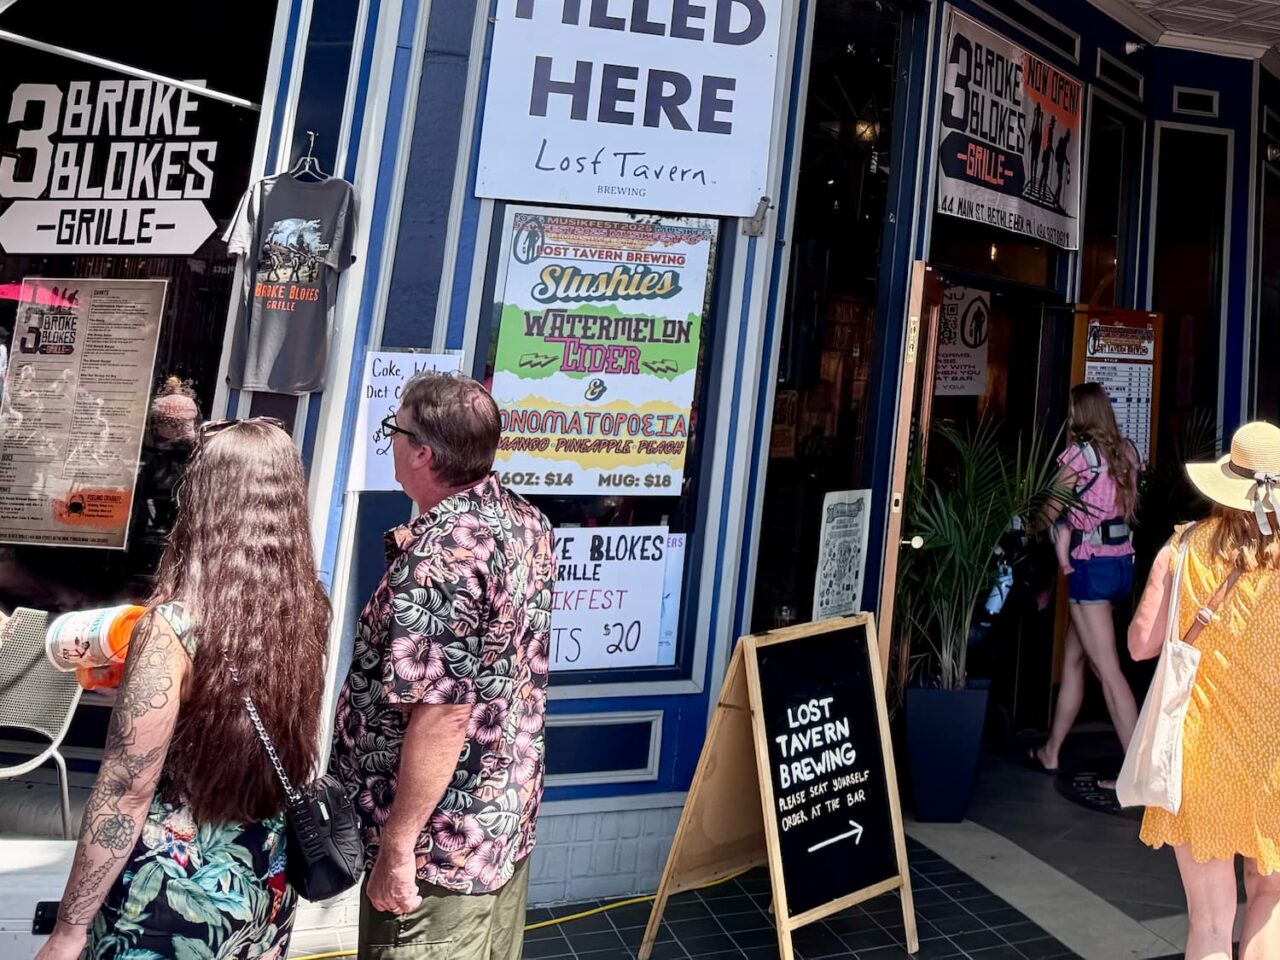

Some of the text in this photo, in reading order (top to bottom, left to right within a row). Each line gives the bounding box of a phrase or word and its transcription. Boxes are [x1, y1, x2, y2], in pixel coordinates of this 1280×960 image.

[941, 32, 973, 133] 3
[973, 42, 1023, 107] BROKE
[1027, 57, 1049, 96] NOW
[62, 79, 208, 136] BROKE
[529, 55, 737, 135] HERE
[1051, 73, 1079, 116] OPEN!
[0, 83, 64, 199] 3
[969, 91, 1026, 155] BLOKES
[50, 141, 218, 200] BLOKES
[535, 139, 606, 176] Lost
[966, 143, 1005, 185] GRILLE
[597, 185, 646, 197] BREWING
[957, 198, 974, 219] MAIN
[56, 208, 156, 246] GRILLE
[547, 217, 619, 230] MUSIKFEST
[537, 245, 686, 265] LOST TAVERN BREWING
[255, 282, 286, 299] BROKE
[531, 263, 682, 304] Slushies
[43, 315, 78, 331] BROKE
[266, 300, 296, 312] GRILLE
[41, 330, 77, 344] BLOKES
[524, 308, 693, 344] WATERMELON
[372, 358, 404, 380] Coke,
[544, 336, 642, 375] CIDER
[366, 384, 388, 399] Diet
[584, 379, 607, 401] &
[555, 437, 631, 454] PINEAPPLE
[637, 440, 685, 455] PEACH
[544, 472, 574, 487] $14
[598, 473, 640, 488] MUG:
[643, 474, 672, 488] $18
[589, 534, 665, 561] BLOKES
[602, 620, 641, 655] $20
[787, 697, 833, 728] LOST
[776, 717, 850, 758] TAVERN
[780, 742, 856, 789] BREWING
[779, 770, 869, 812] PLEASE SEAT YOURSELF
[782, 789, 866, 832] ORDER AT THE BAR
